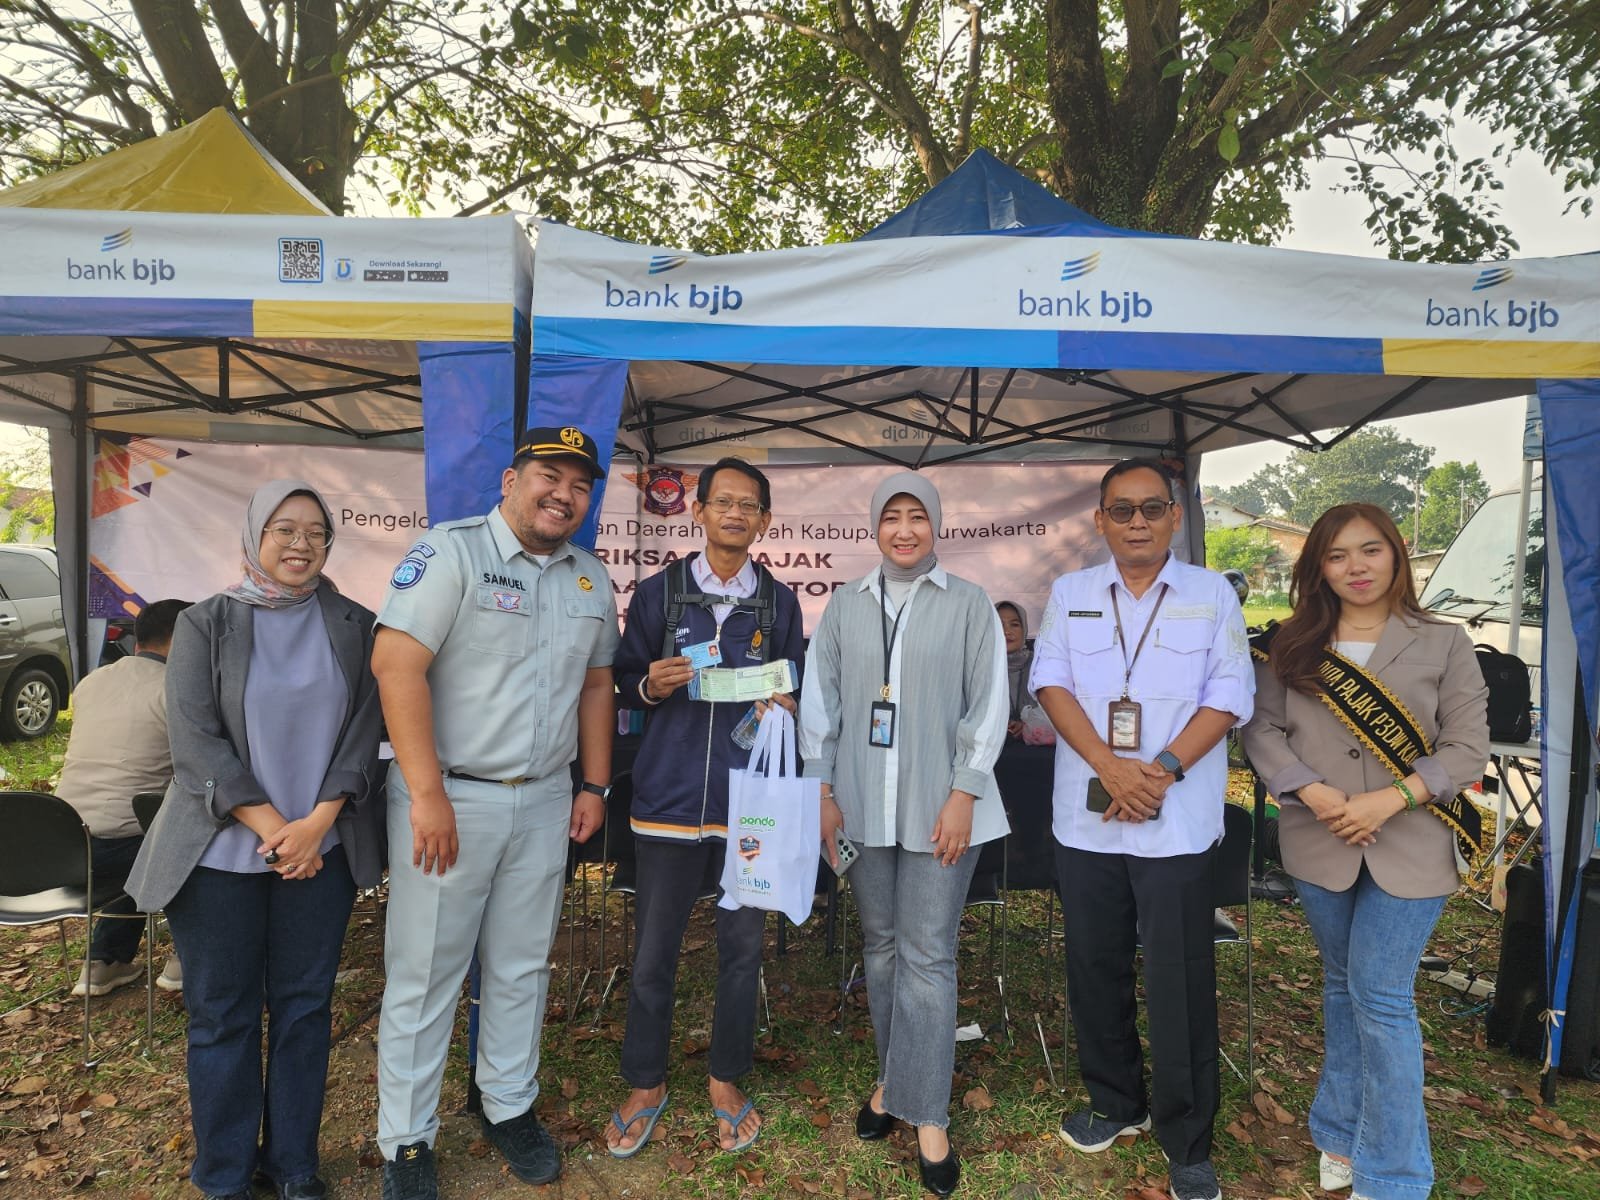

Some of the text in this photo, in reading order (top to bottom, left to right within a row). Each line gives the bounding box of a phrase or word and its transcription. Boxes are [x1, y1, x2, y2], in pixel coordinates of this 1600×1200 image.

[67, 257, 175, 285] bank bjb
[369, 260, 442, 269] Download Sekarang!
[605, 279, 743, 315] bank bjb
[1019, 289, 1153, 323] bank bjb
[1426, 298, 1560, 333] bank bjb
[341, 508, 429, 531] Pengelo
[595, 522, 618, 536] an
[626, 519, 703, 538] Daerah
[801, 523, 876, 543] Kabupa
[938, 521, 1046, 540] urwakarta
[595, 548, 833, 568] RIKSA AJAK
[483, 572, 527, 591] SAMUEL
[1334, 678, 1382, 721] PAJAK
[754, 877, 771, 890] bjb
